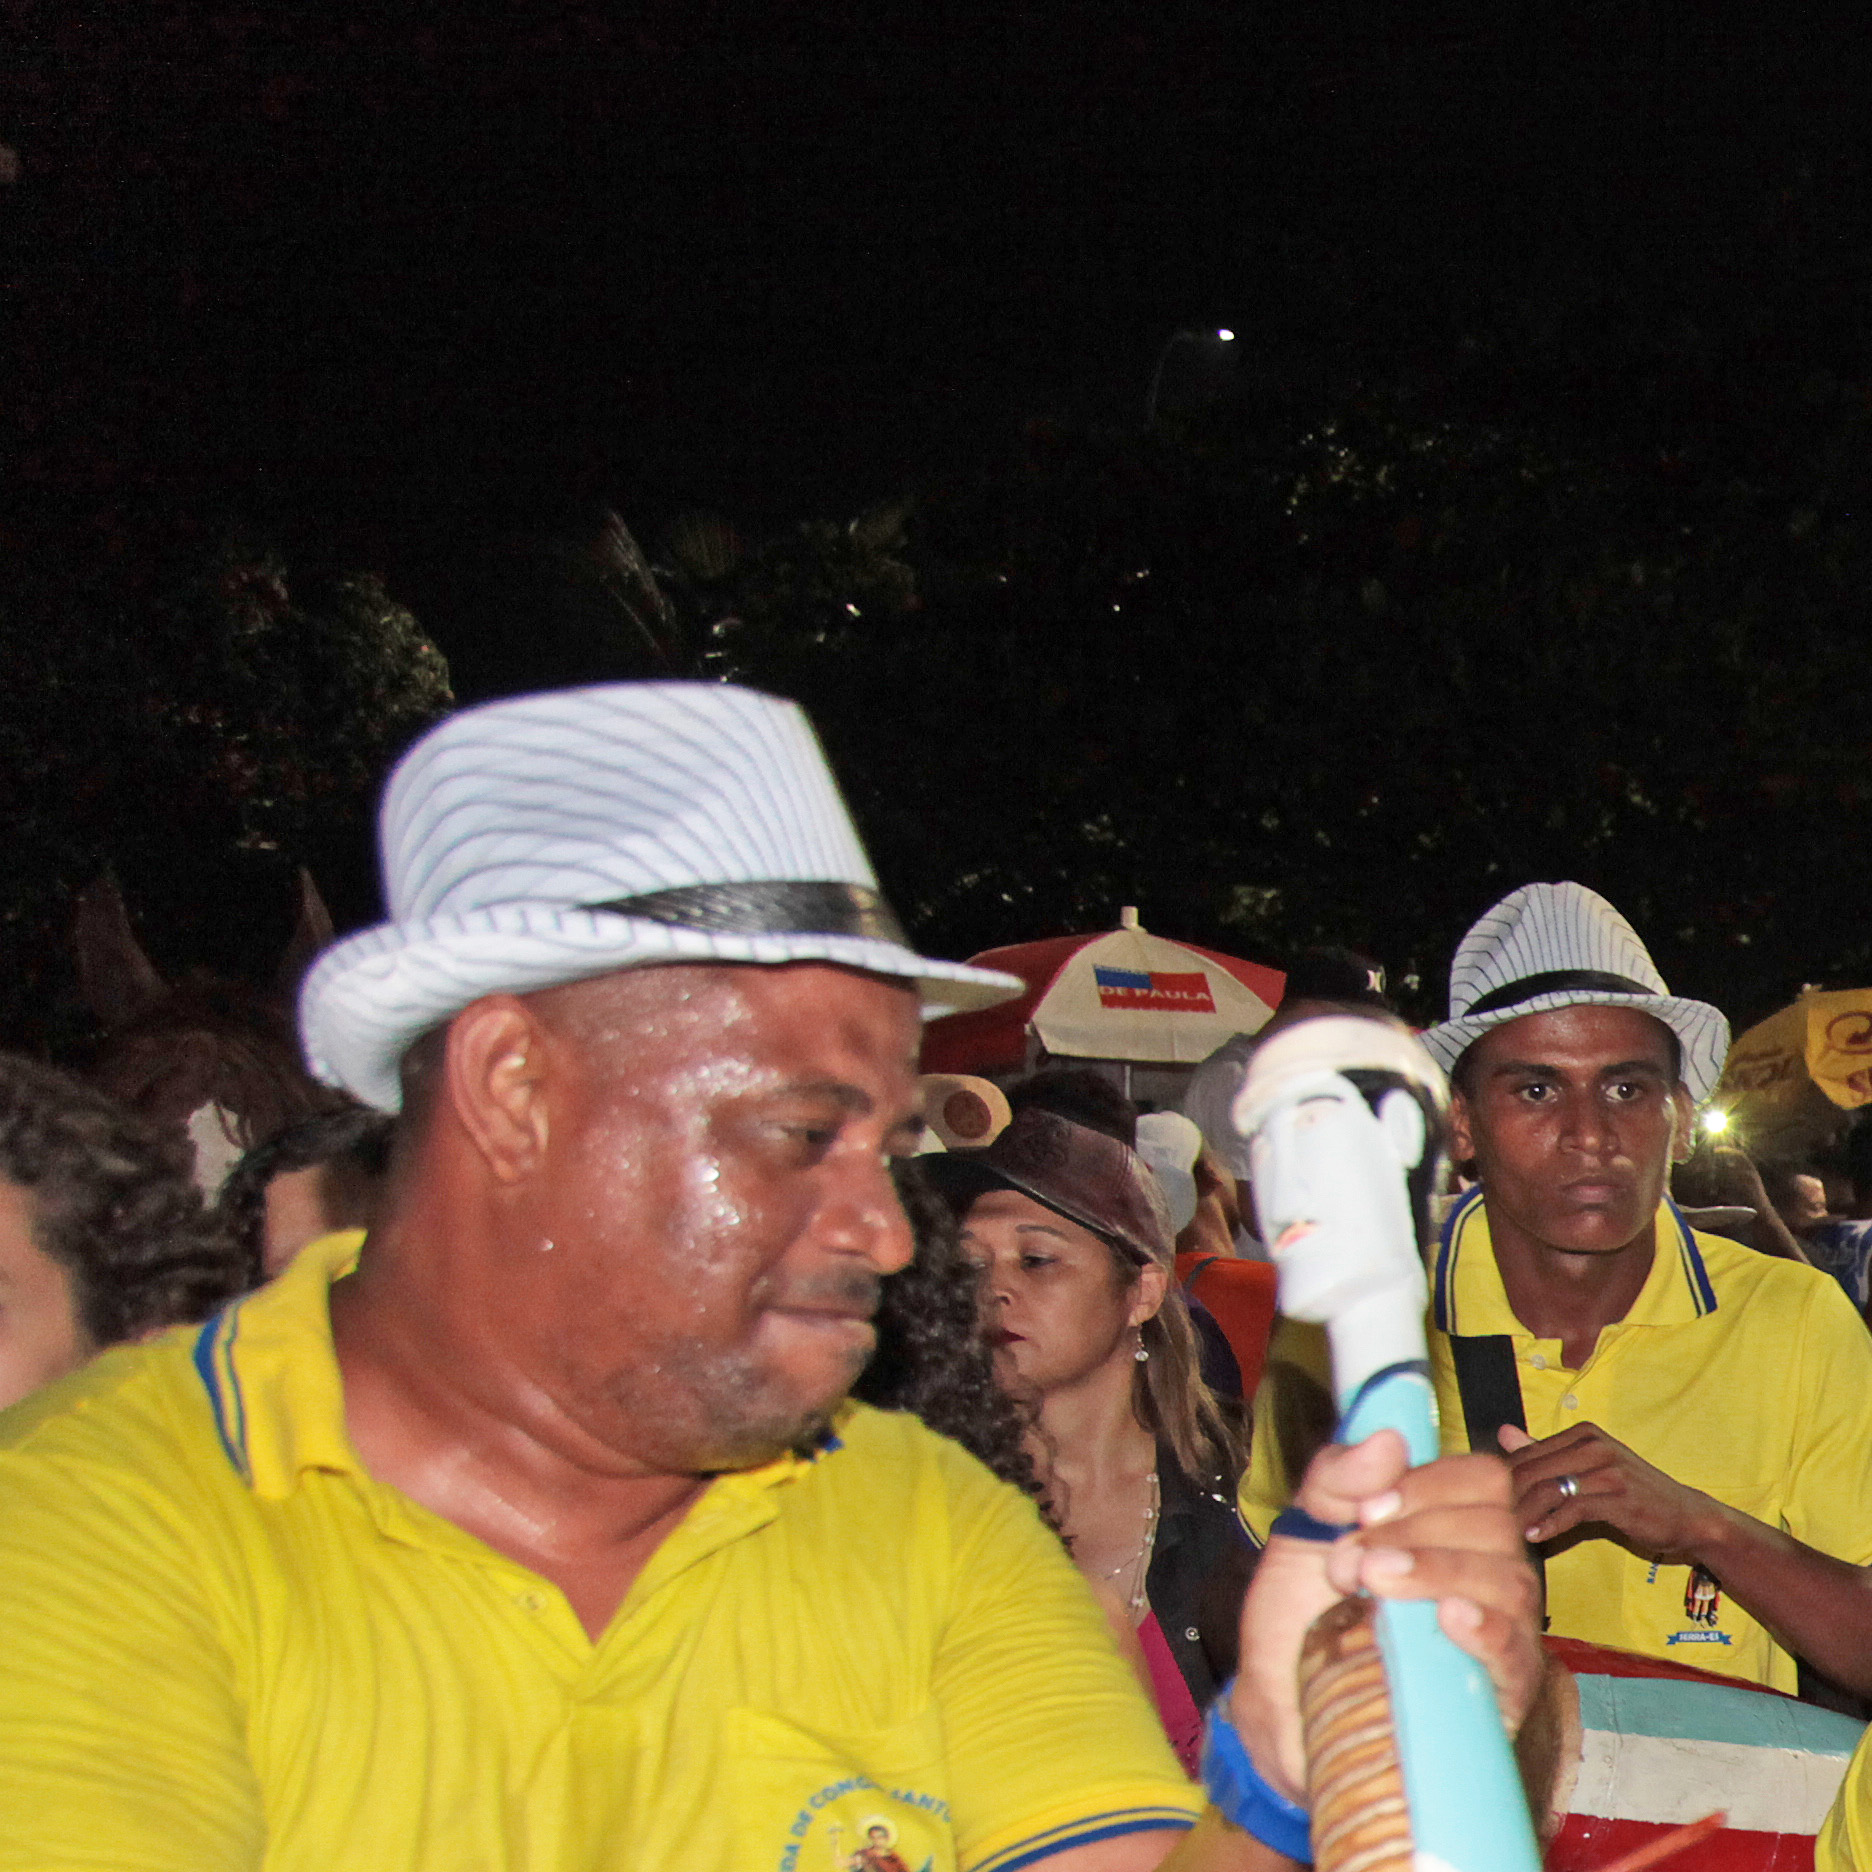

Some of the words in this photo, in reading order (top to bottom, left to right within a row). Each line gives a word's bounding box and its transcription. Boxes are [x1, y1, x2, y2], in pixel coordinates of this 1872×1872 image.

[1100, 986, 1128, 996] DE
[1134, 989, 1211, 1000] PAULA
[790, 1810, 814, 1837] DE
